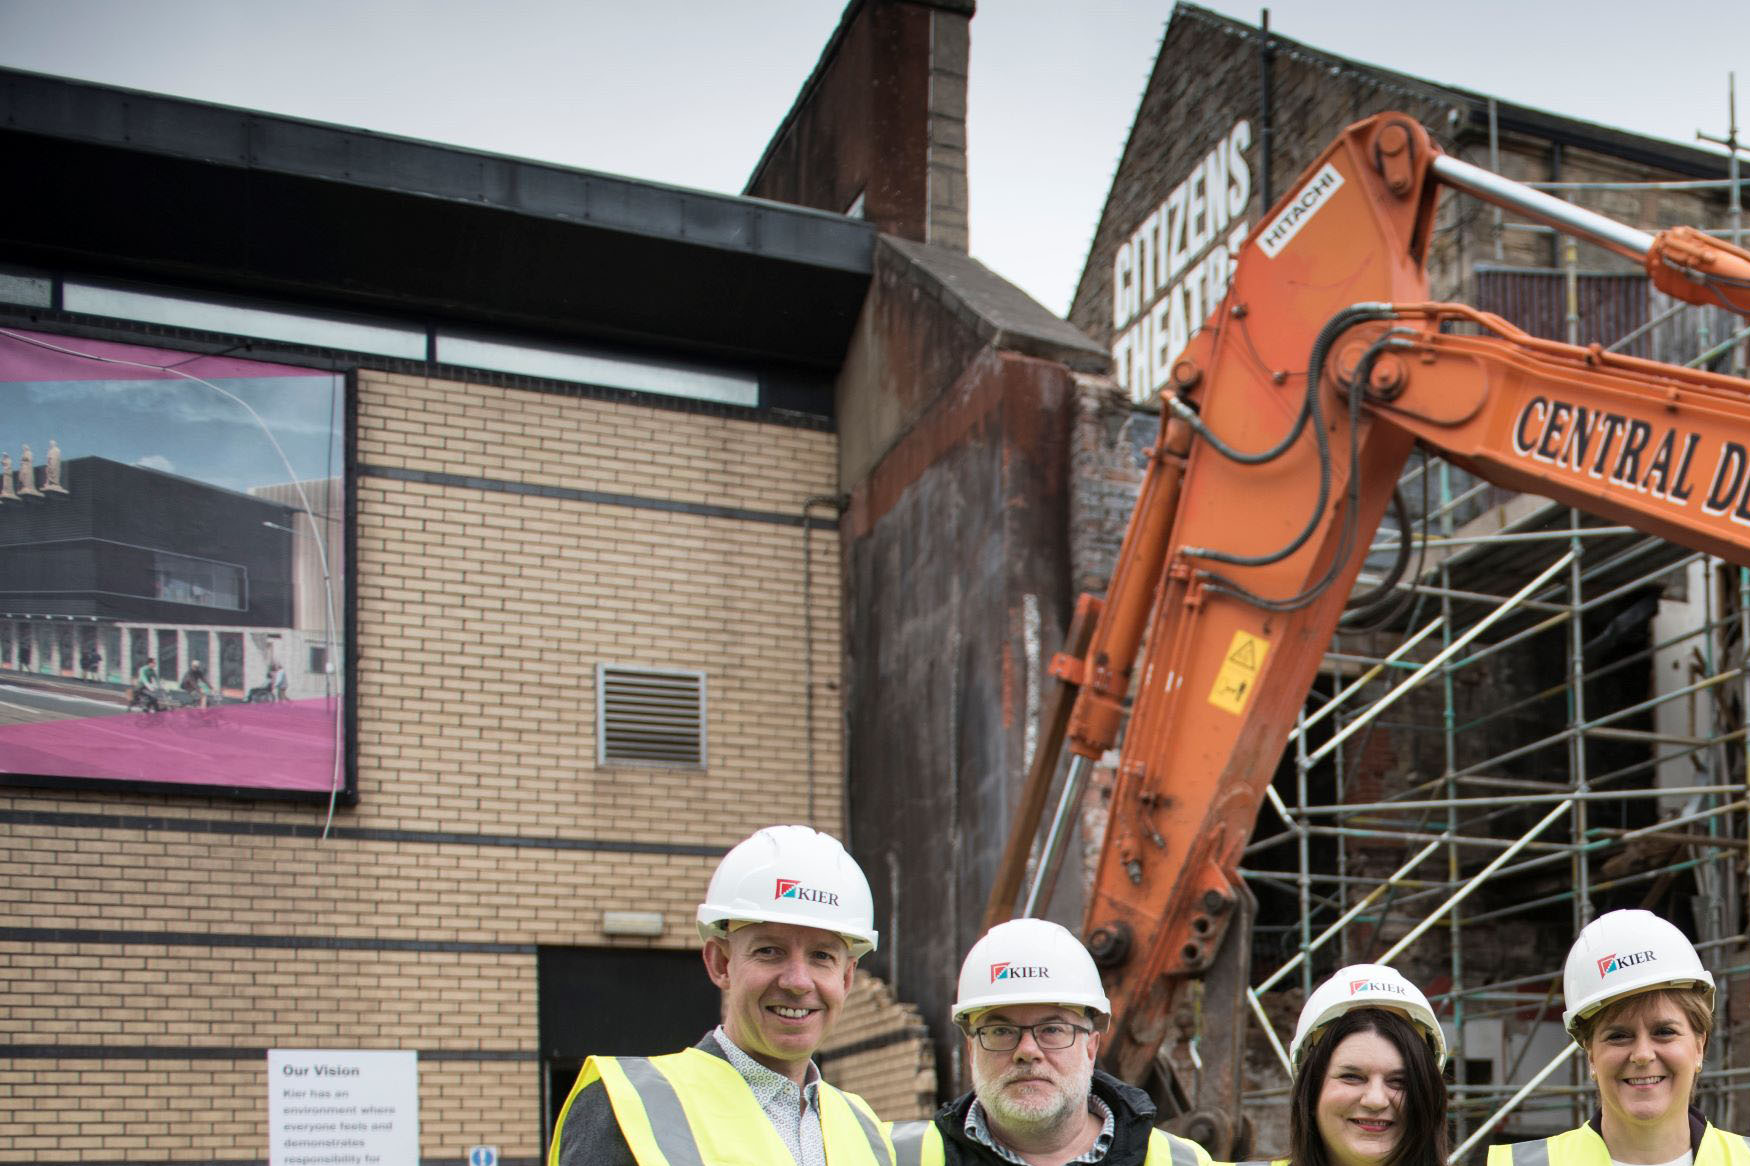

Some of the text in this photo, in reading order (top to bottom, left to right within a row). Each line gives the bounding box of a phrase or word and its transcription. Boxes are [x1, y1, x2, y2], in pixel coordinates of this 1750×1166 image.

[1265, 171, 1336, 249] HITACHI
[1113, 119, 1250, 331] CITIZENS
[1512, 396, 1701, 506] CENTRAL
[798, 886, 839, 907] KIER
[1616, 949, 1656, 969] KIER
[1009, 966, 1050, 979] KIER
[1369, 982, 1406, 996] KIER
[283, 1064, 360, 1076] Our Vision
[310, 1088, 331, 1098] has
[283, 1105, 396, 1114] environment where
[283, 1123, 336, 1132] everyone
[371, 1121, 393, 1131] and
[284, 1138, 365, 1147] demonstrates
[284, 1154, 361, 1165] responsibility
